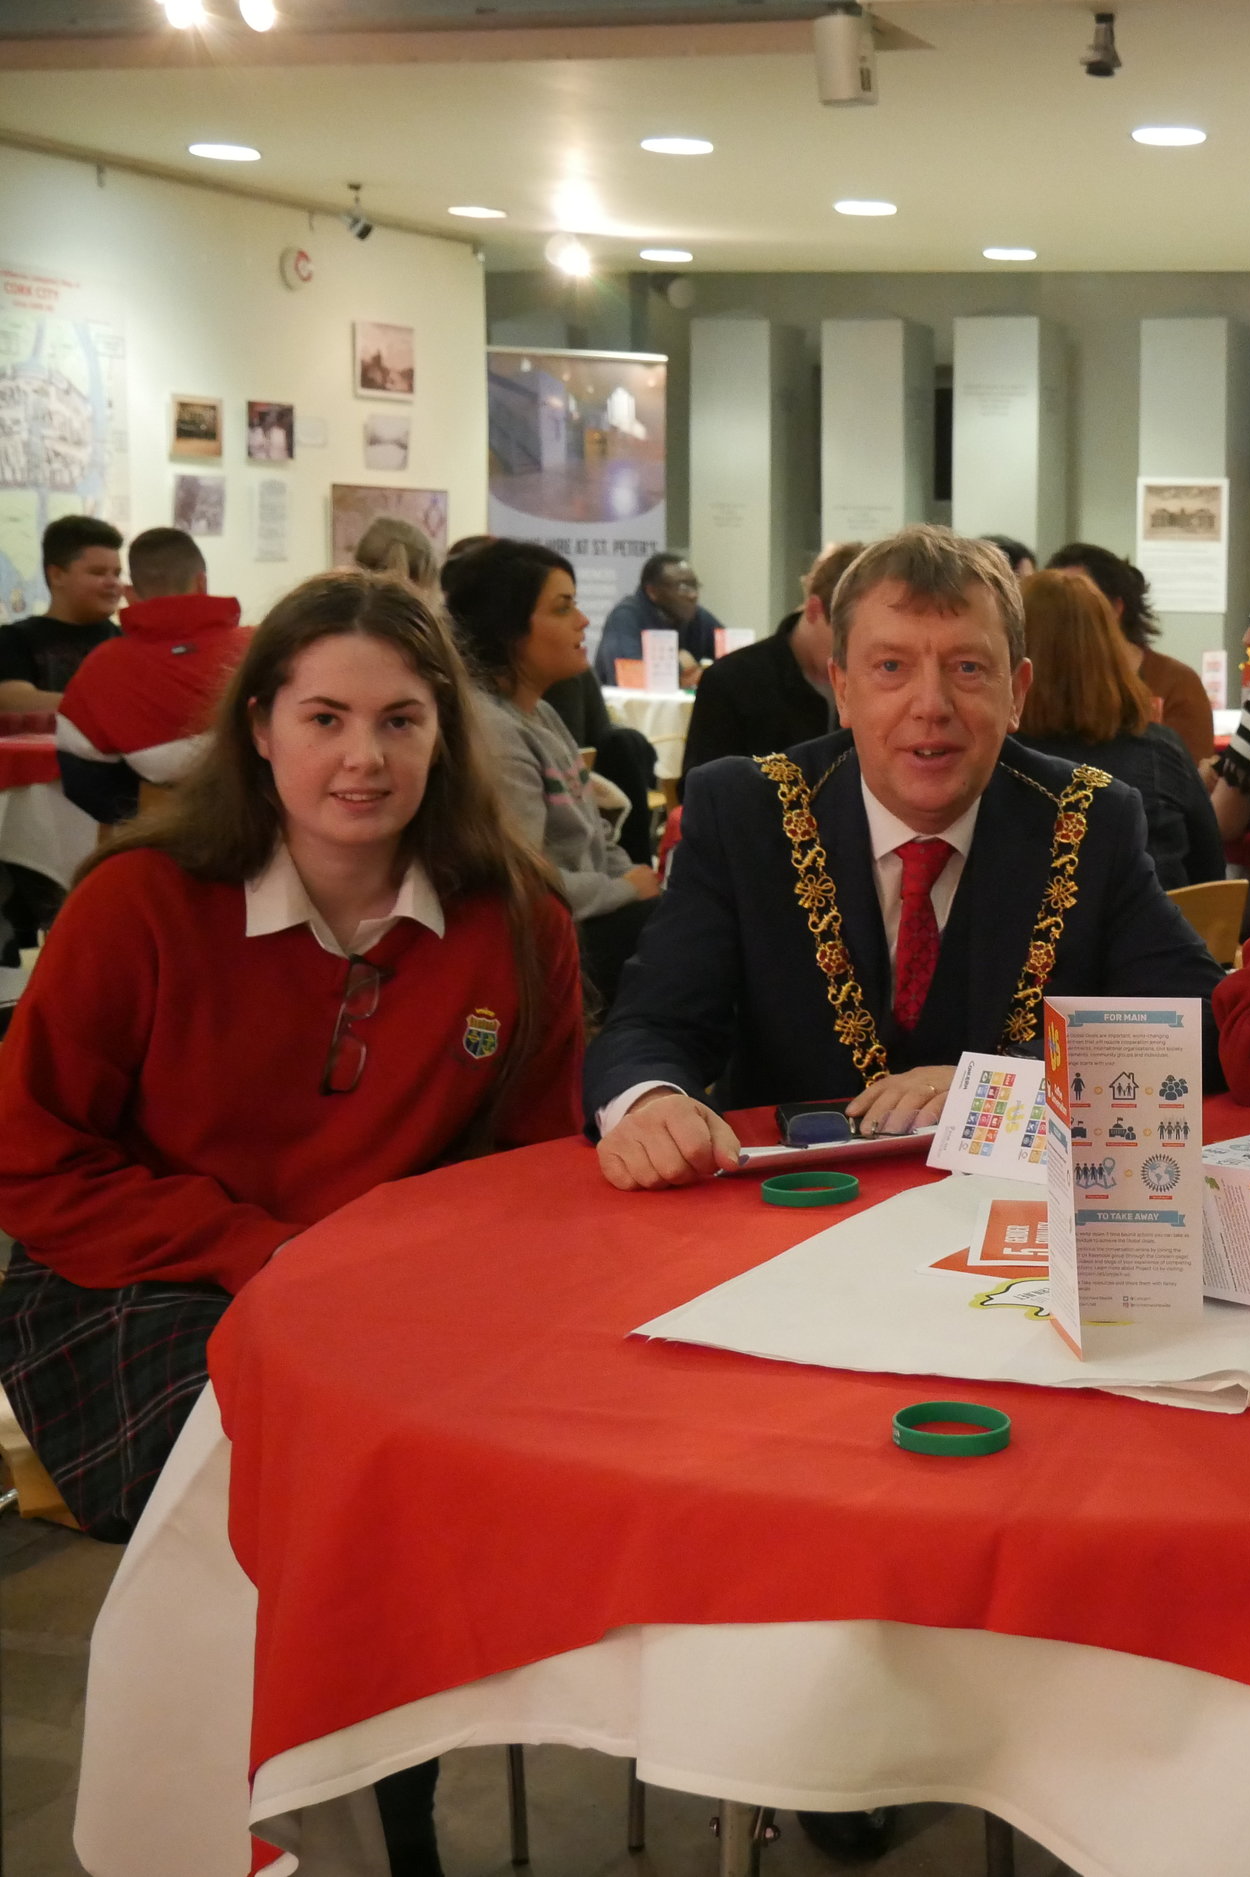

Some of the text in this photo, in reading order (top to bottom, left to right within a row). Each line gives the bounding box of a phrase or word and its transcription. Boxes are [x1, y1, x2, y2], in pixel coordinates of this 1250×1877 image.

[1104, 1013, 1148, 1021] FOR MAIN
[1097, 1212, 1160, 1221] TO TAKE AWAY
